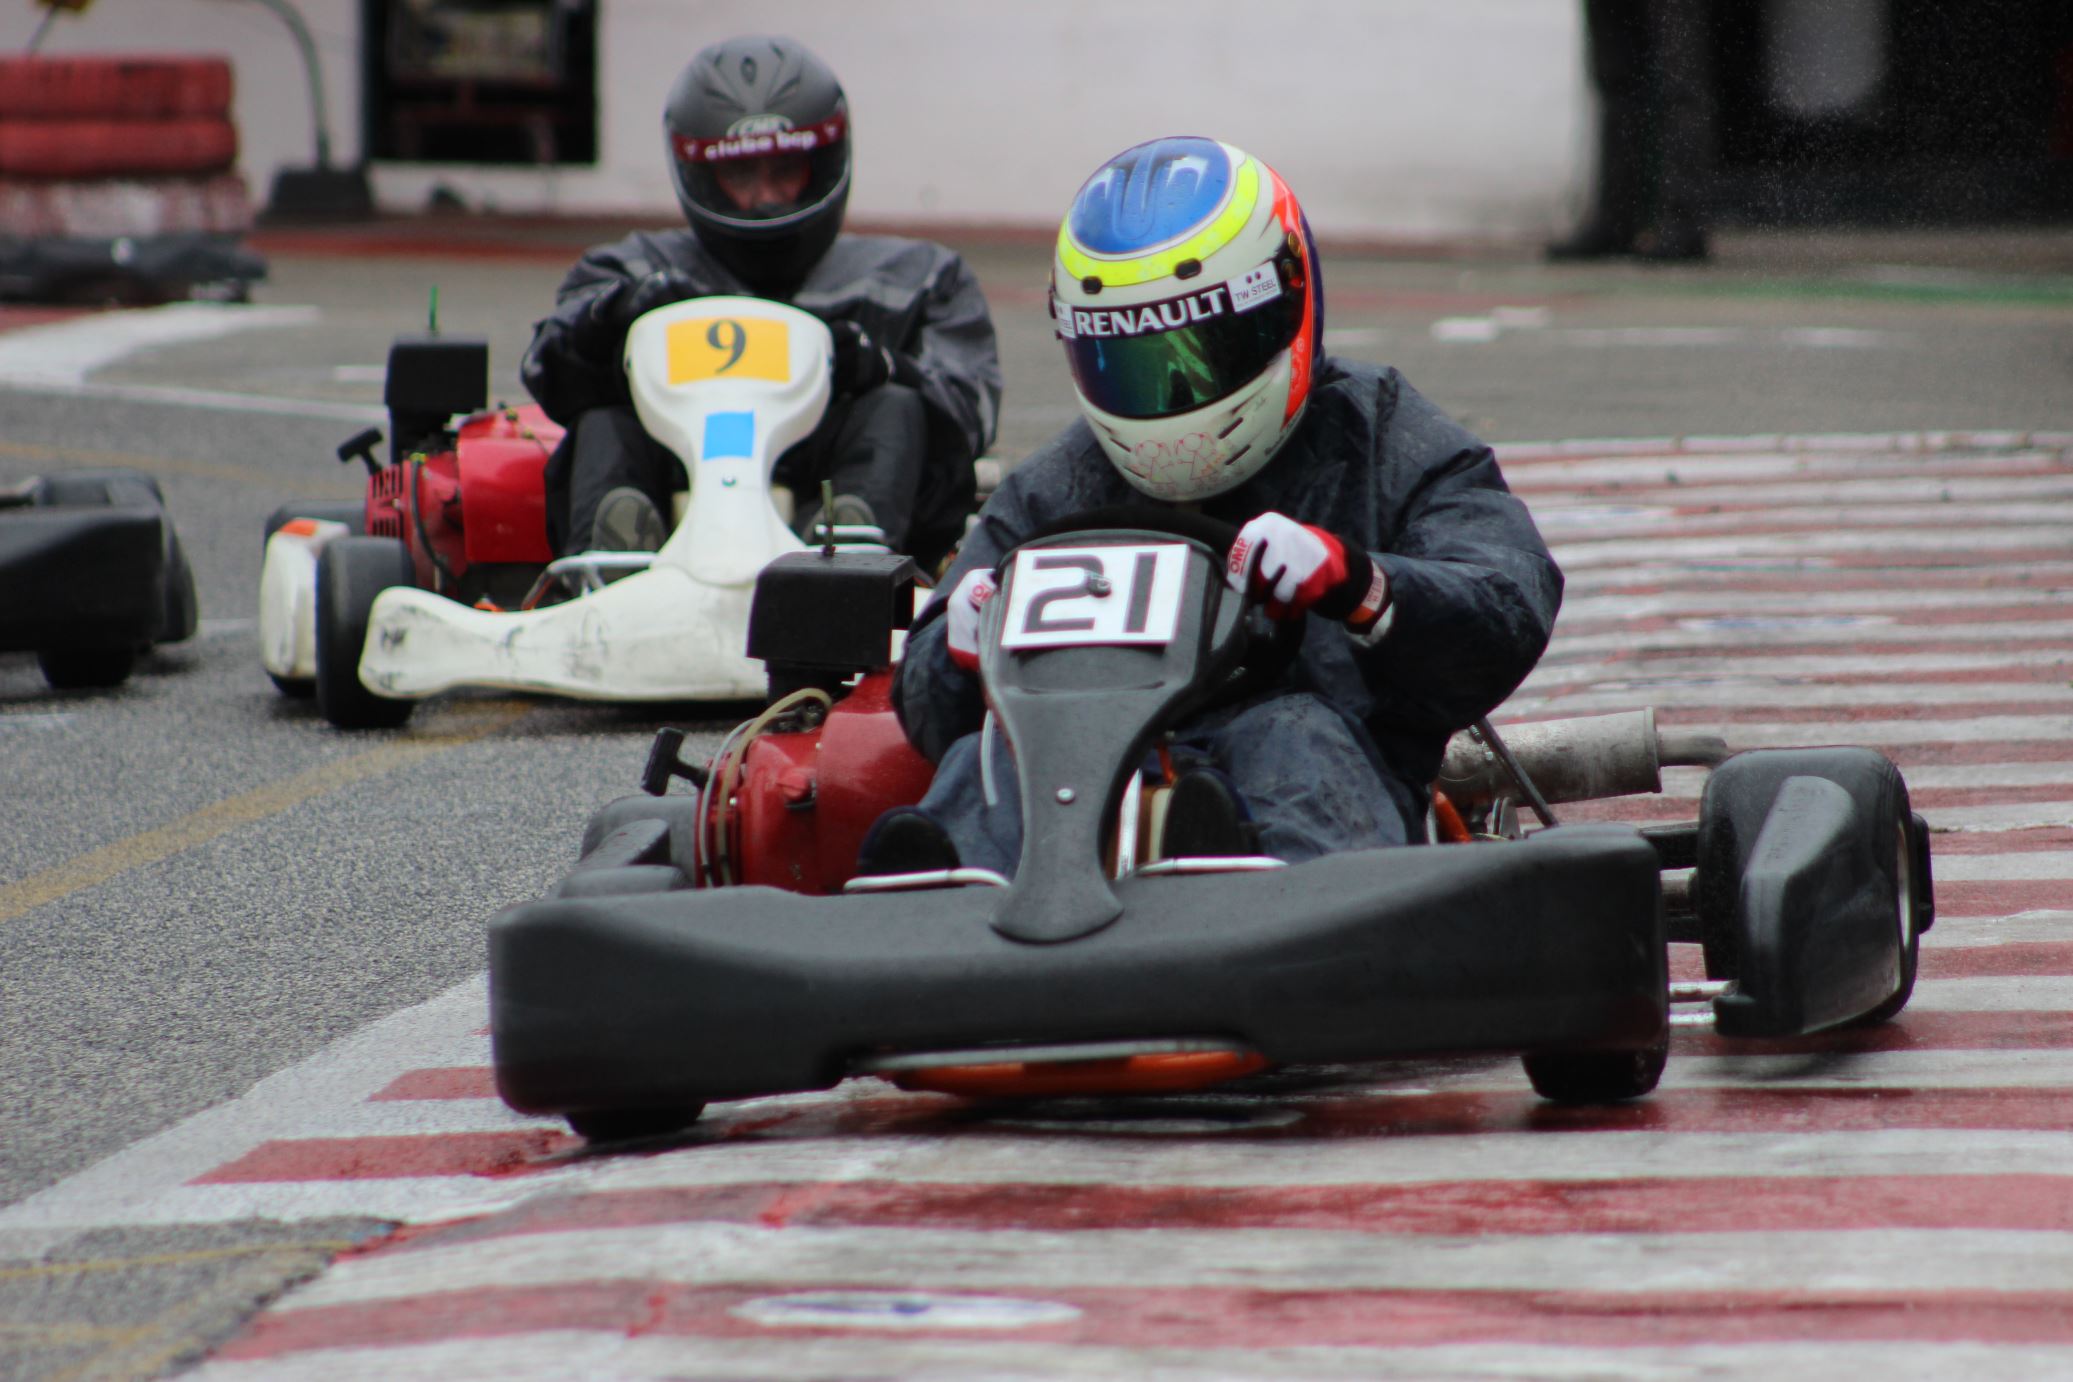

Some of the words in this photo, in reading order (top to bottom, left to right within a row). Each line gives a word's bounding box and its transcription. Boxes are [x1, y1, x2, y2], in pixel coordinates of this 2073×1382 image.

[1074, 287, 1226, 336] RENAULT
[1235, 288, 1249, 301] TW
[1251, 278, 1277, 296] STEEL
[706, 319, 746, 374] 9
[1230, 537, 1247, 574] OMP
[1022, 552, 1158, 634] 21
